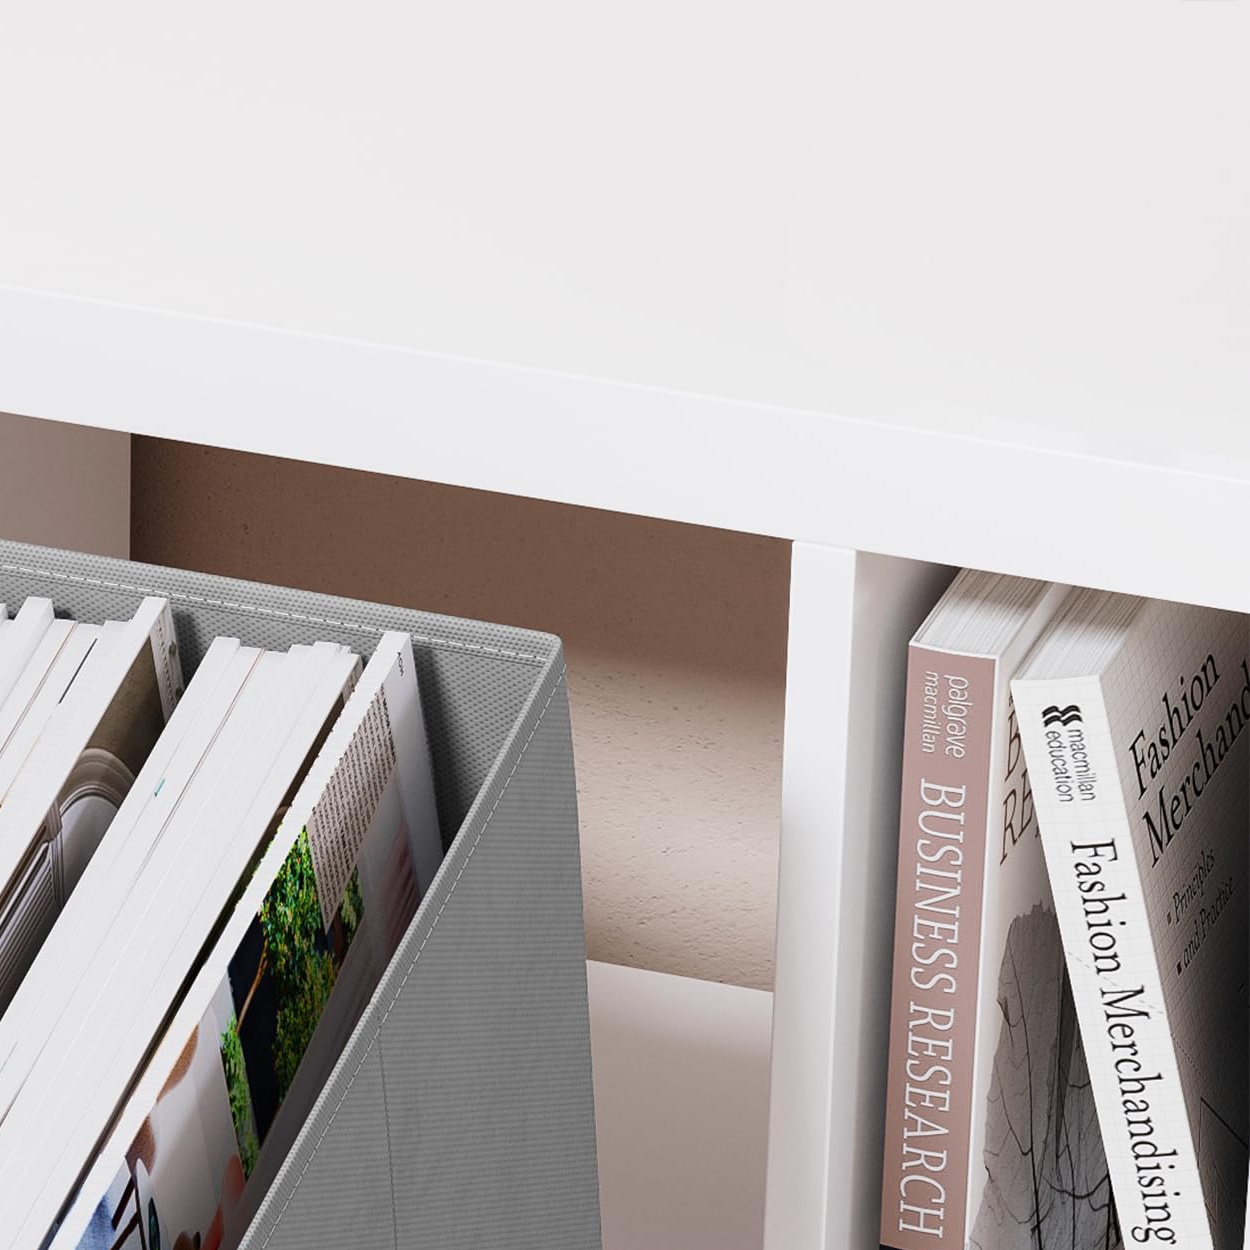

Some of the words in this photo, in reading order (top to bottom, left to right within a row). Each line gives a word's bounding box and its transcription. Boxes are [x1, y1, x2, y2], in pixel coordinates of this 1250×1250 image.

[922, 671, 941, 753] macmillan
[944, 675, 974, 760] palgrave
[1129, 652, 1220, 800] Fashion
[1046, 730, 1074, 803] education
[1068, 729, 1097, 802] macmillan
[910, 778, 966, 994] BUSINESS
[1172, 849, 1214, 925] Principles
[1182, 919, 1201, 968] and
[1070, 838, 1127, 975] Fashion
[1101, 985, 1182, 1245] Merchandising
[898, 1001, 954, 1239] RESEARCH
